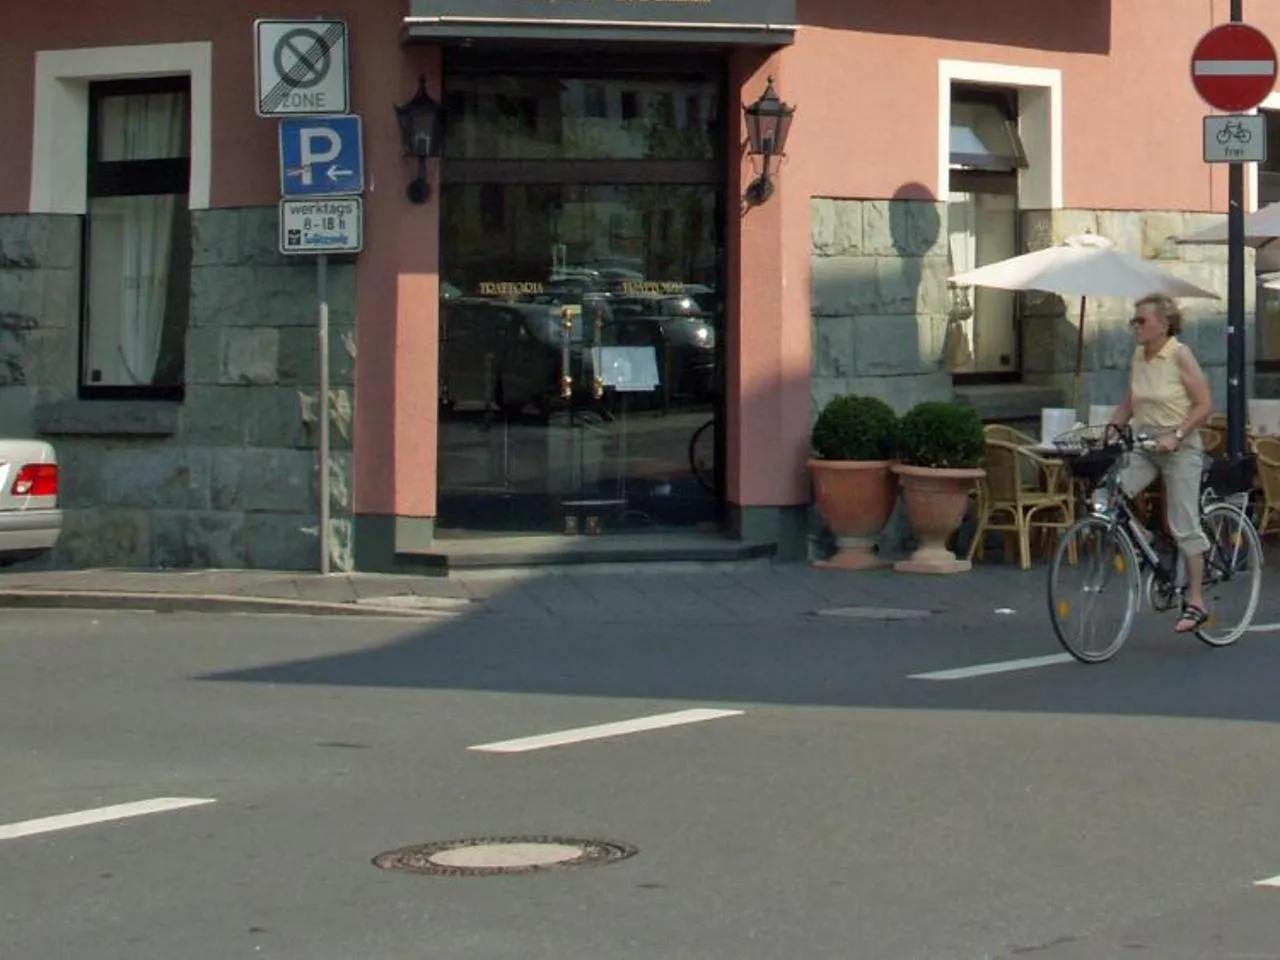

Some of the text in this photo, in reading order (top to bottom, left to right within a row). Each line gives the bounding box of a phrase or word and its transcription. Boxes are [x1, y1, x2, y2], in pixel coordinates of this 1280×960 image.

[282, 92, 325, 108] ZONE
[299, 126, 342, 186] P
[1223, 146, 1244, 157] frei
[289, 203, 353, 217] werktags
[480, 281, 544, 295] TRATTORIA
